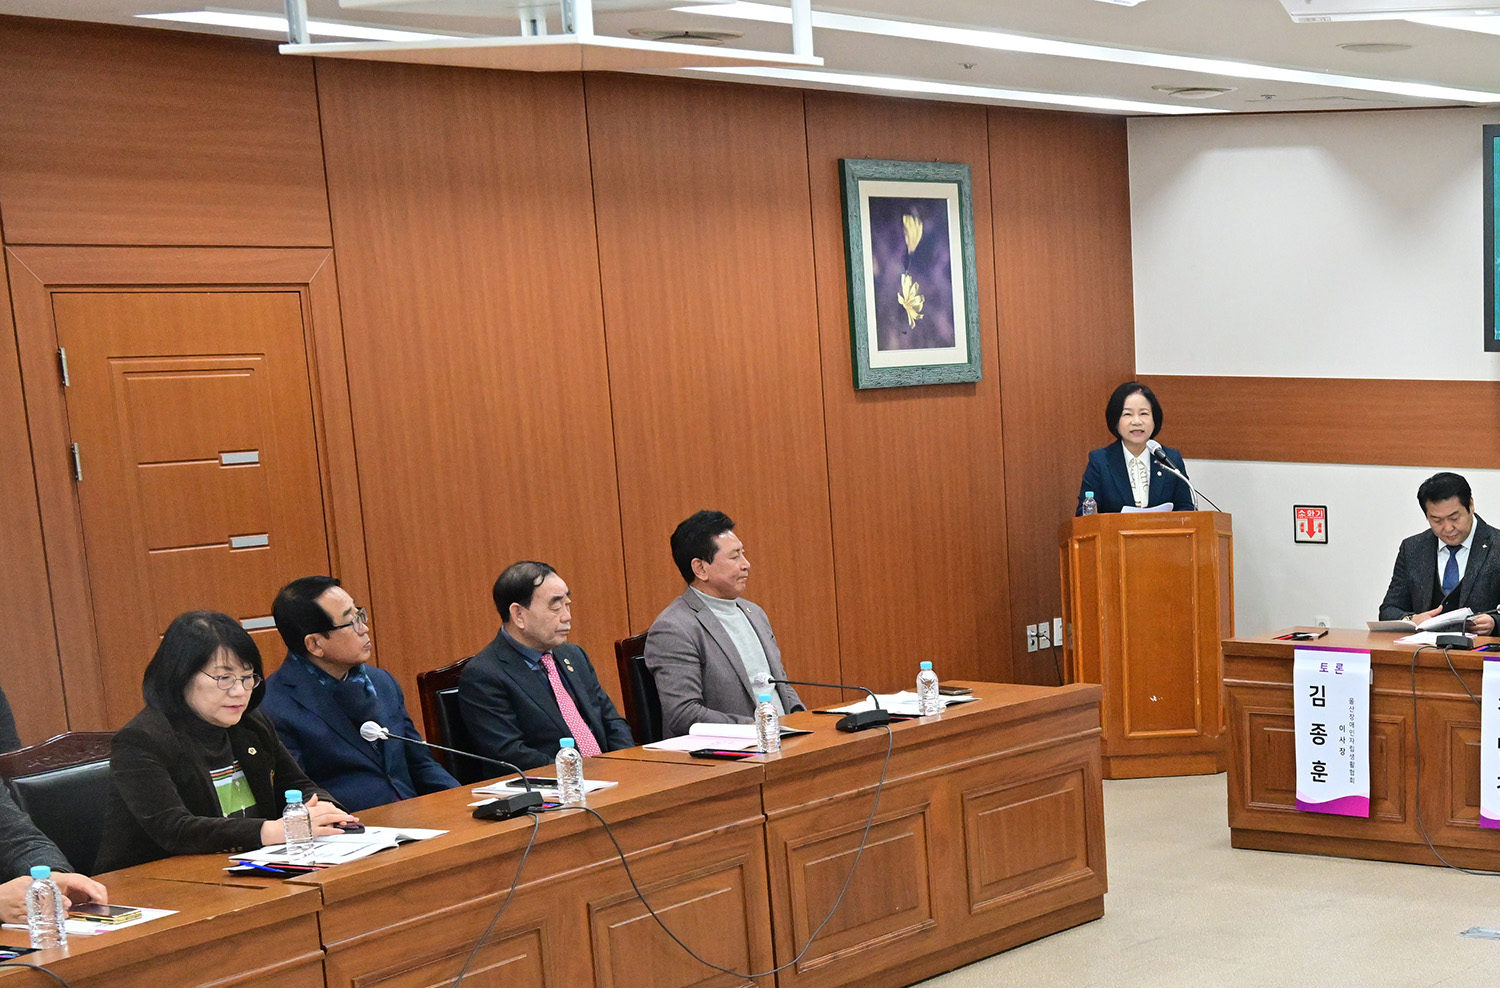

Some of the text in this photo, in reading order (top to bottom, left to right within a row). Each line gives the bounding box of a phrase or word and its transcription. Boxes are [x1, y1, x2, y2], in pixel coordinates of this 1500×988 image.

[1298, 509, 1324, 517] 소화기
[1318, 662, 1344, 675] 토론
[1308, 685, 1329, 783] 김종훈
[1338, 724, 1347, 757] 이사장
